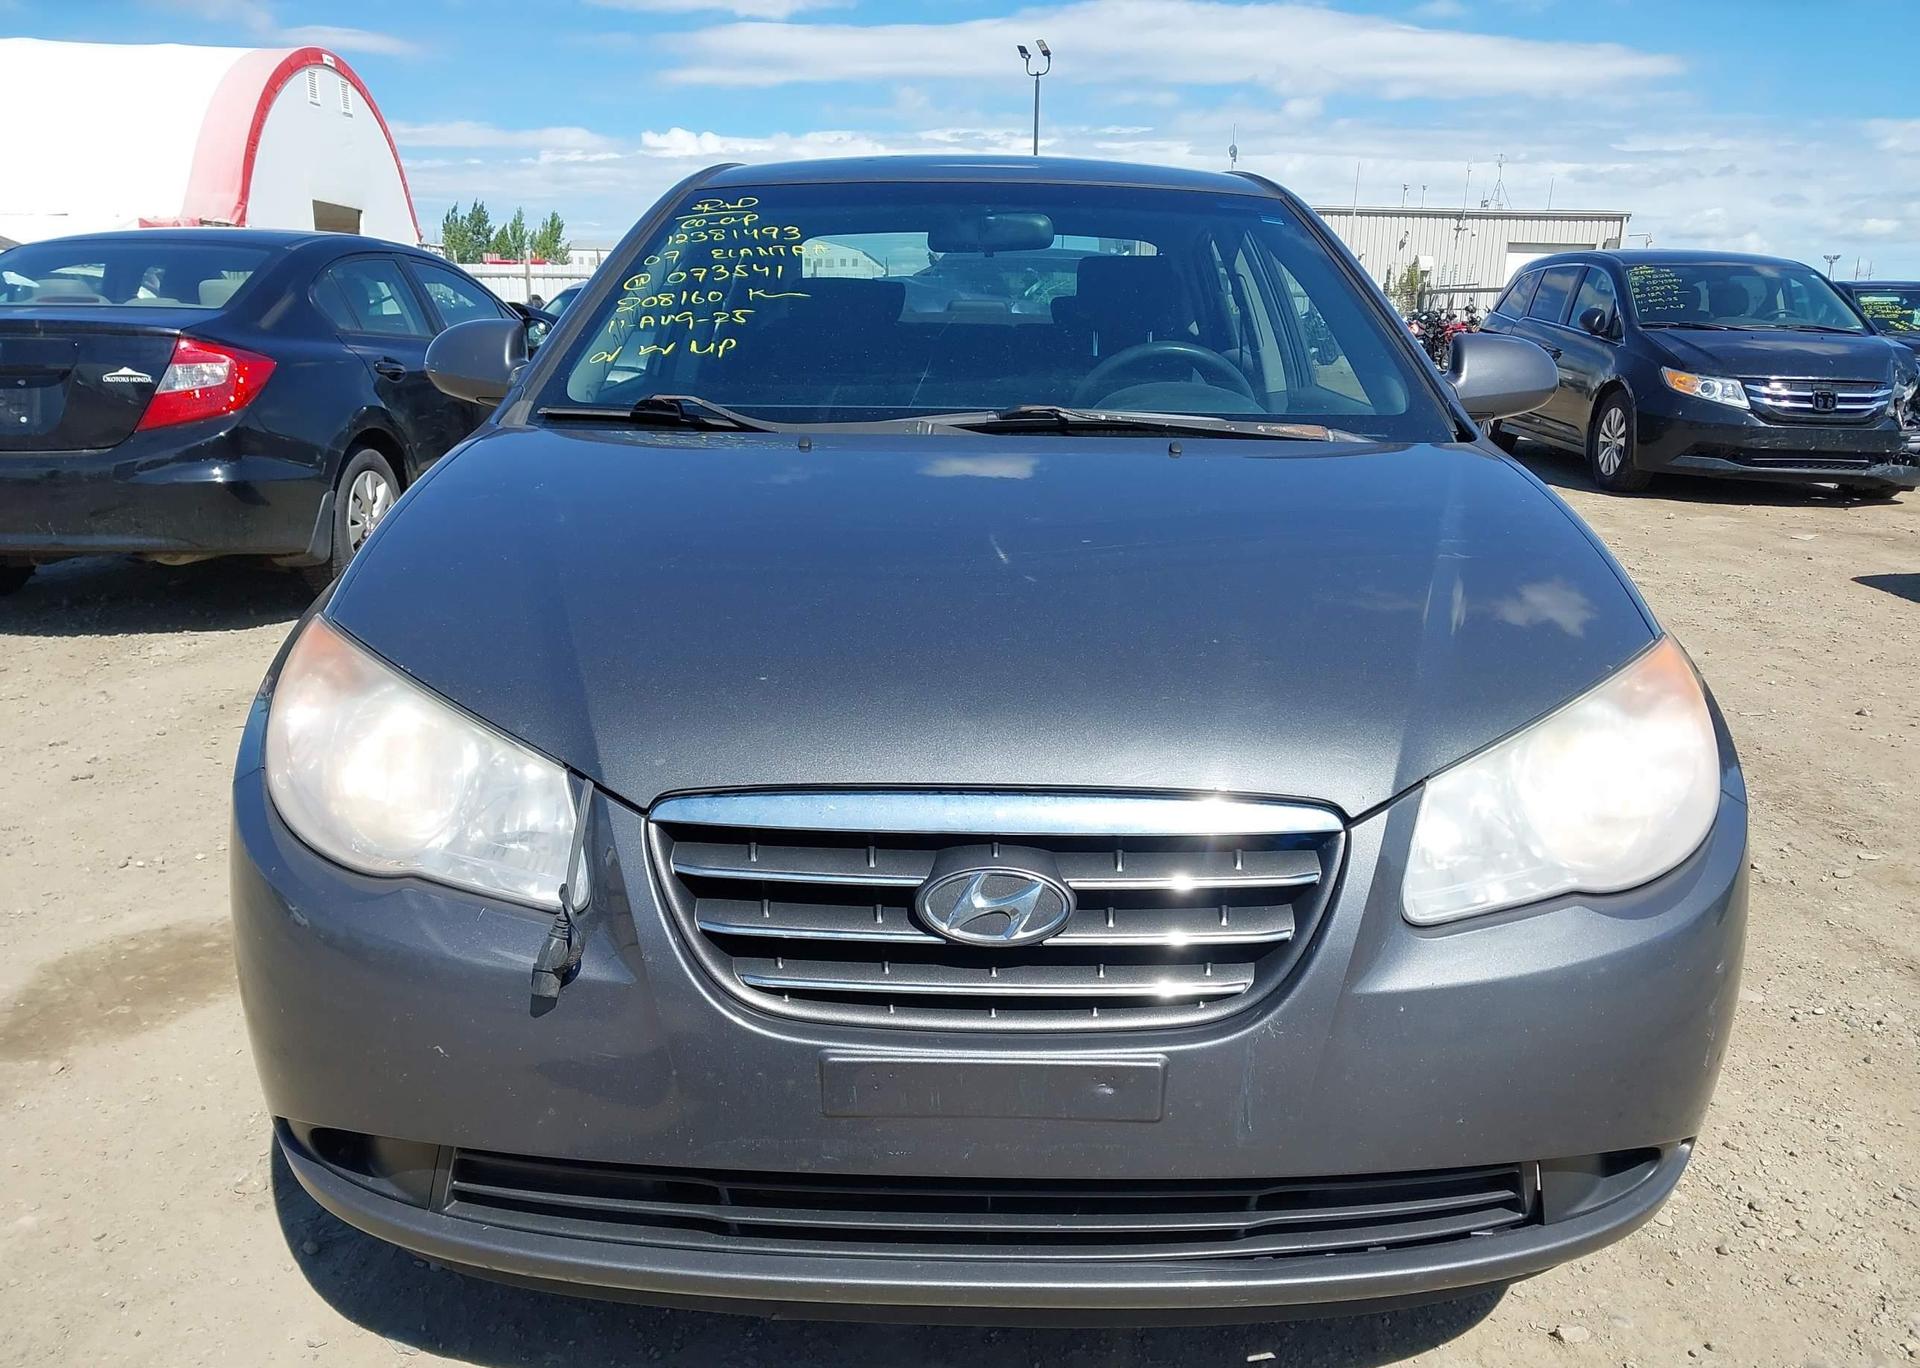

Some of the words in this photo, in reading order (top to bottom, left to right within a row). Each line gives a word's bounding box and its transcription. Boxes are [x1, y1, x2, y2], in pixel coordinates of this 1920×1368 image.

[667, 226, 801, 245] 12381493
[643, 250, 679, 265] 07
[667, 263, 783, 283] 073541
[616, 290, 722, 312] 208160
[130, 375, 153, 383] HONDA
